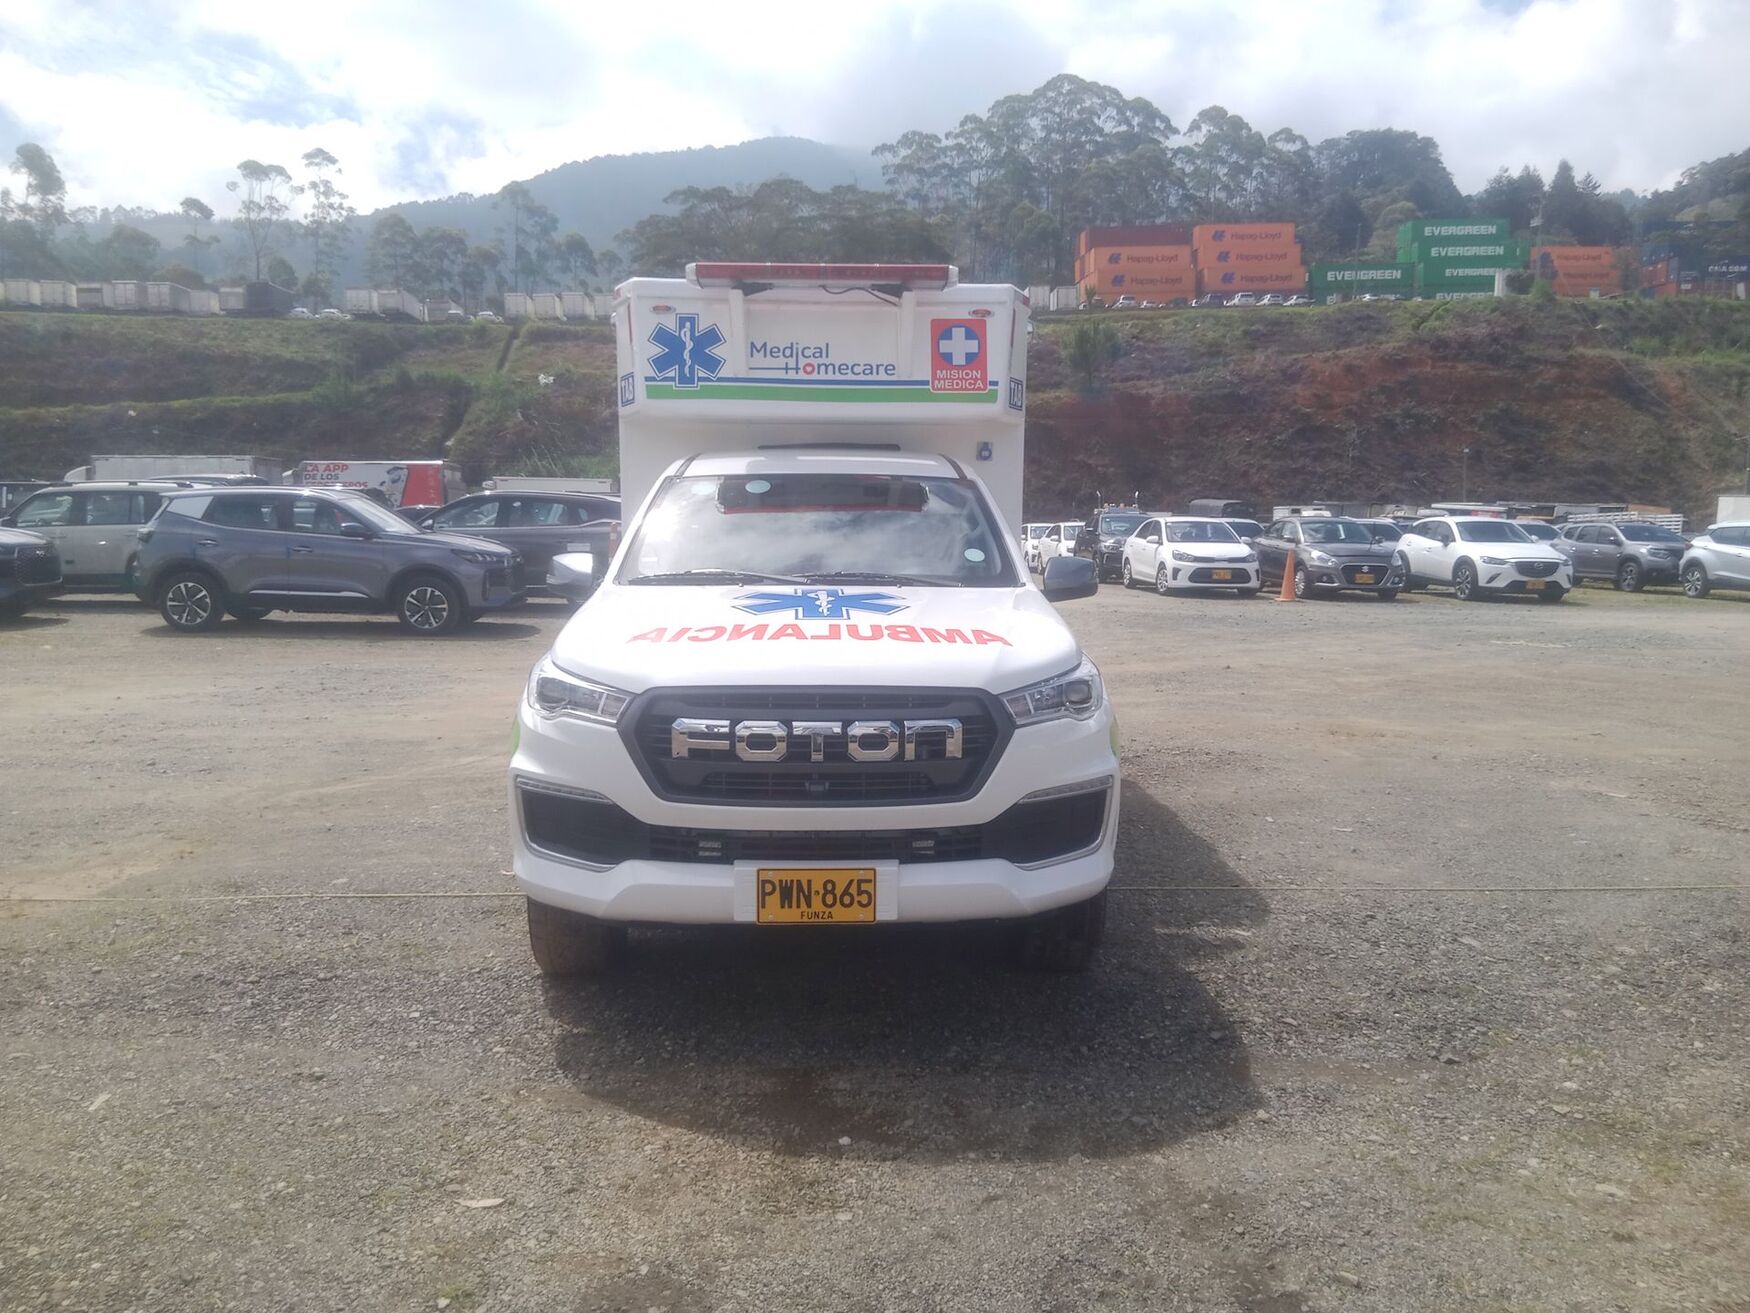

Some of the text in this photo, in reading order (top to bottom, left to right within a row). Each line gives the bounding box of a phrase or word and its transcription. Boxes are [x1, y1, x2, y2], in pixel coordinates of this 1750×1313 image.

[1424, 225, 1497, 236] EVERGREEN
[1430, 246, 1504, 257] EVERGREEN
[750, 341, 829, 359] Medical
[785, 362, 896, 376] Homecare
[936, 370, 981, 379] MISION
[934, 380, 984, 389] MEDICA
[304, 463, 349, 473] LA APP
[800, 911, 833, 920] FUNZA
